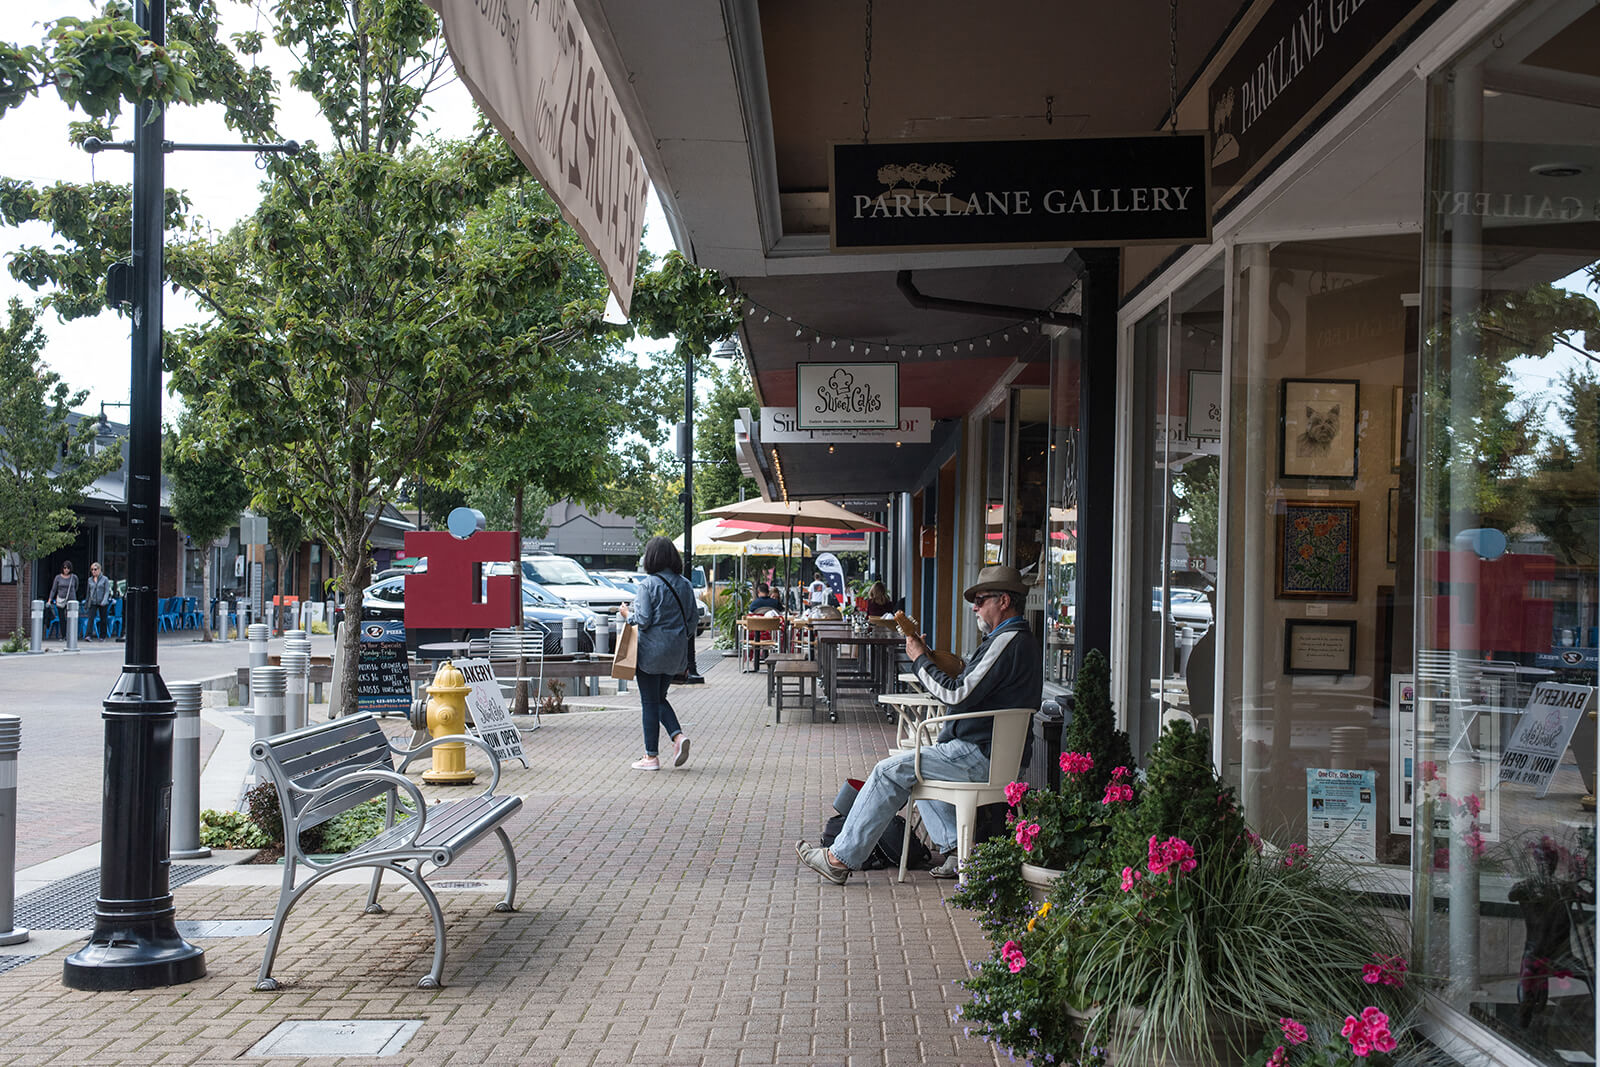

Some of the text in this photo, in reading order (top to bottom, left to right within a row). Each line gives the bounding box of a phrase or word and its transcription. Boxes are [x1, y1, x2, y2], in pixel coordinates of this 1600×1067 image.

[1240, 0, 1325, 135] PARKLANE
[852, 186, 1194, 219] PARKLANE GALLERY
[500, 728, 520, 746] OPEN
